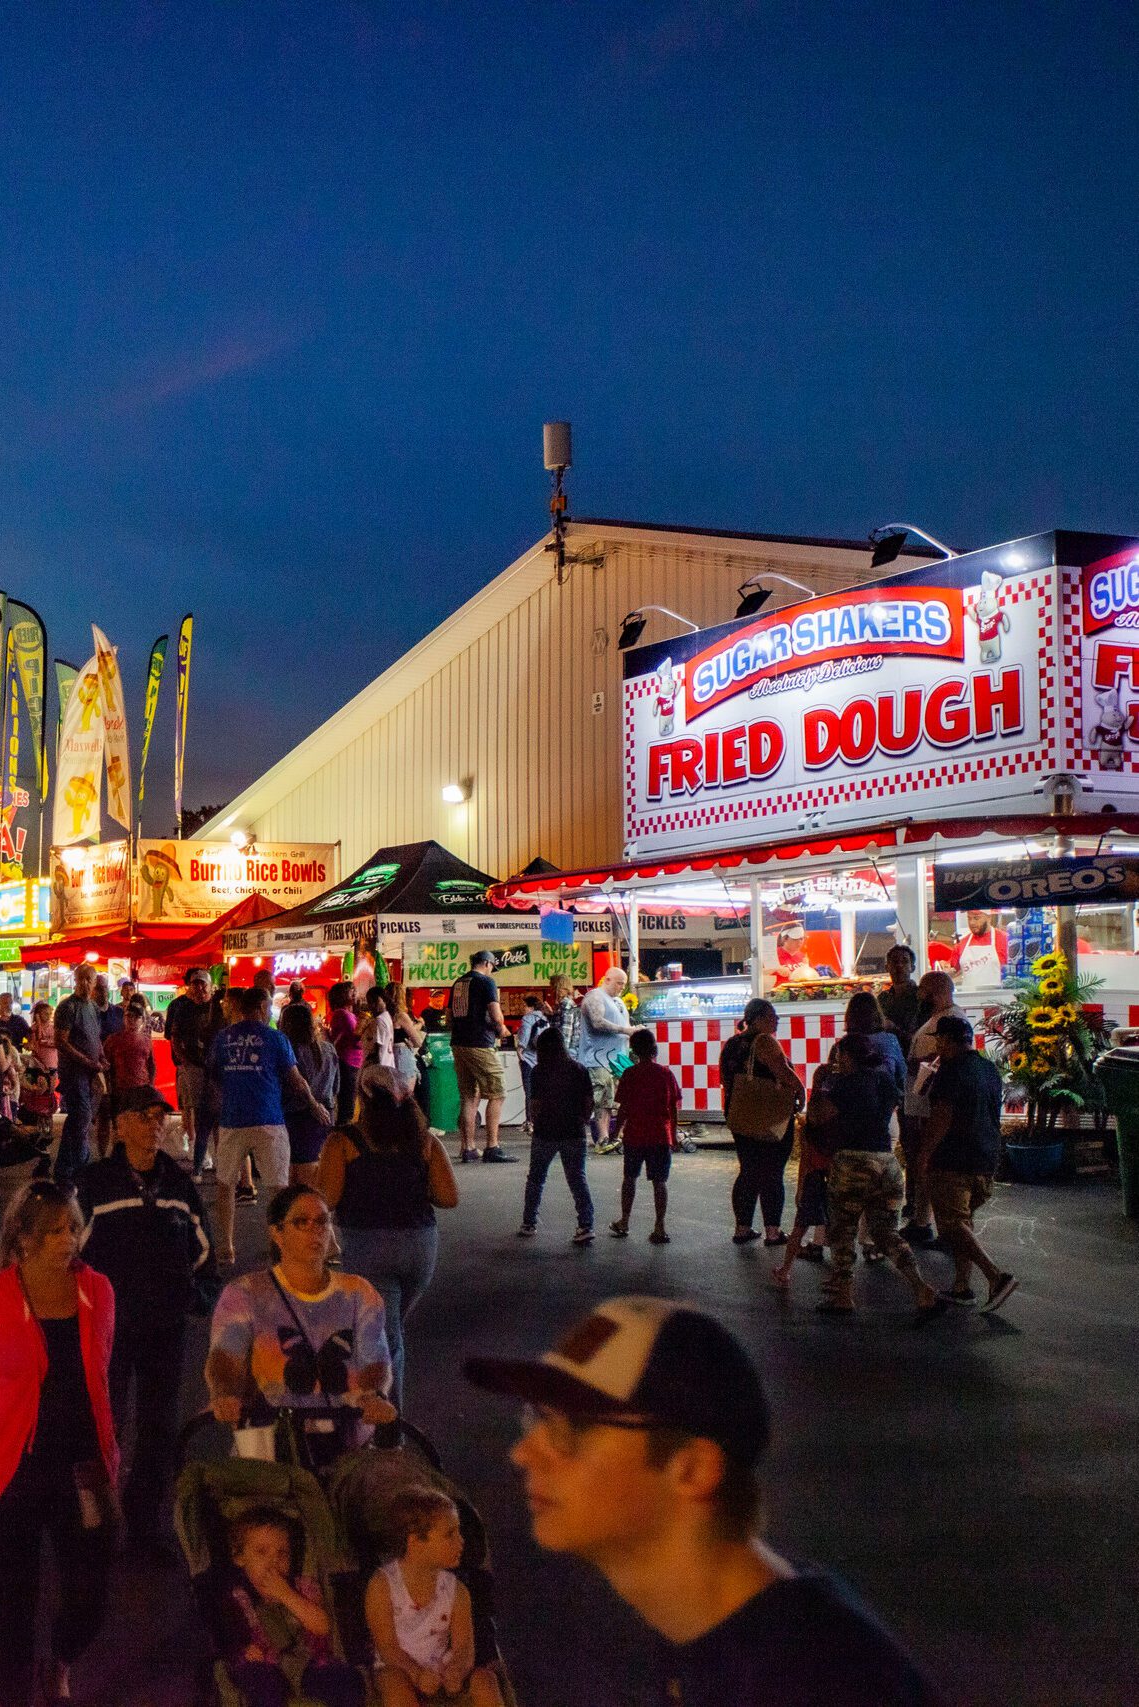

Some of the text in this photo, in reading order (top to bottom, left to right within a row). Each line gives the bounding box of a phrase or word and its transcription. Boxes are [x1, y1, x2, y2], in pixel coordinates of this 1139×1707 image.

[695, 602, 950, 702] SUGAR SHAKERS
[750, 654, 883, 699] Absolutely Delicious
[646, 717, 786, 800] FRIED
[802, 665, 1024, 769] DOUGH
[191, 859, 326, 882] Burro Rice Bowls
[943, 864, 1031, 885] Deep Fried
[284, 887, 302, 895] Chili
[988, 865, 1125, 900] OREOS
[184, 910, 211, 918] Salad
[323, 918, 377, 941] FRIED PICKLES
[380, 921, 421, 934] PICKLES
[417, 941, 459, 960] FRIED
[541, 941, 580, 960] FRIED
